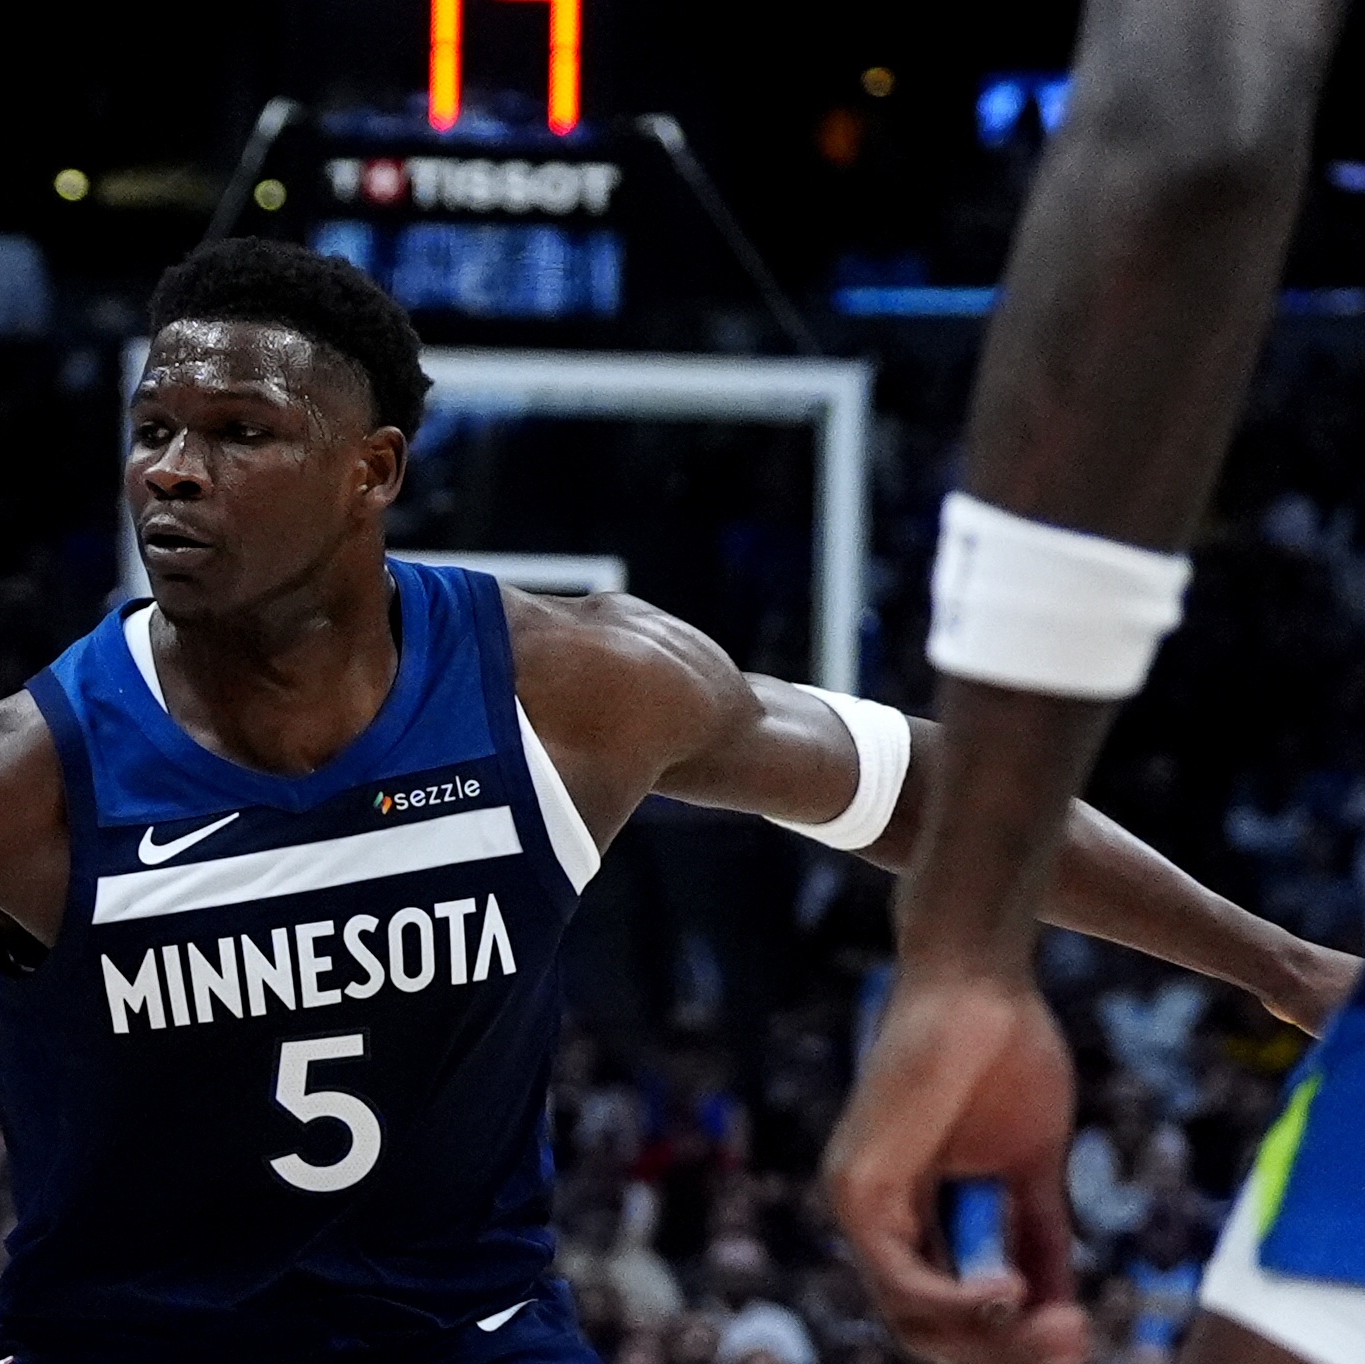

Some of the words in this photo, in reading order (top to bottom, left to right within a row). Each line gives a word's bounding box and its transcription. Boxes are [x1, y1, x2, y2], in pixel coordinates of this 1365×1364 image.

[394, 774, 481, 812] sezzle
[100, 892, 518, 1034] MINNESOTA
[269, 1033, 383, 1193] 5
